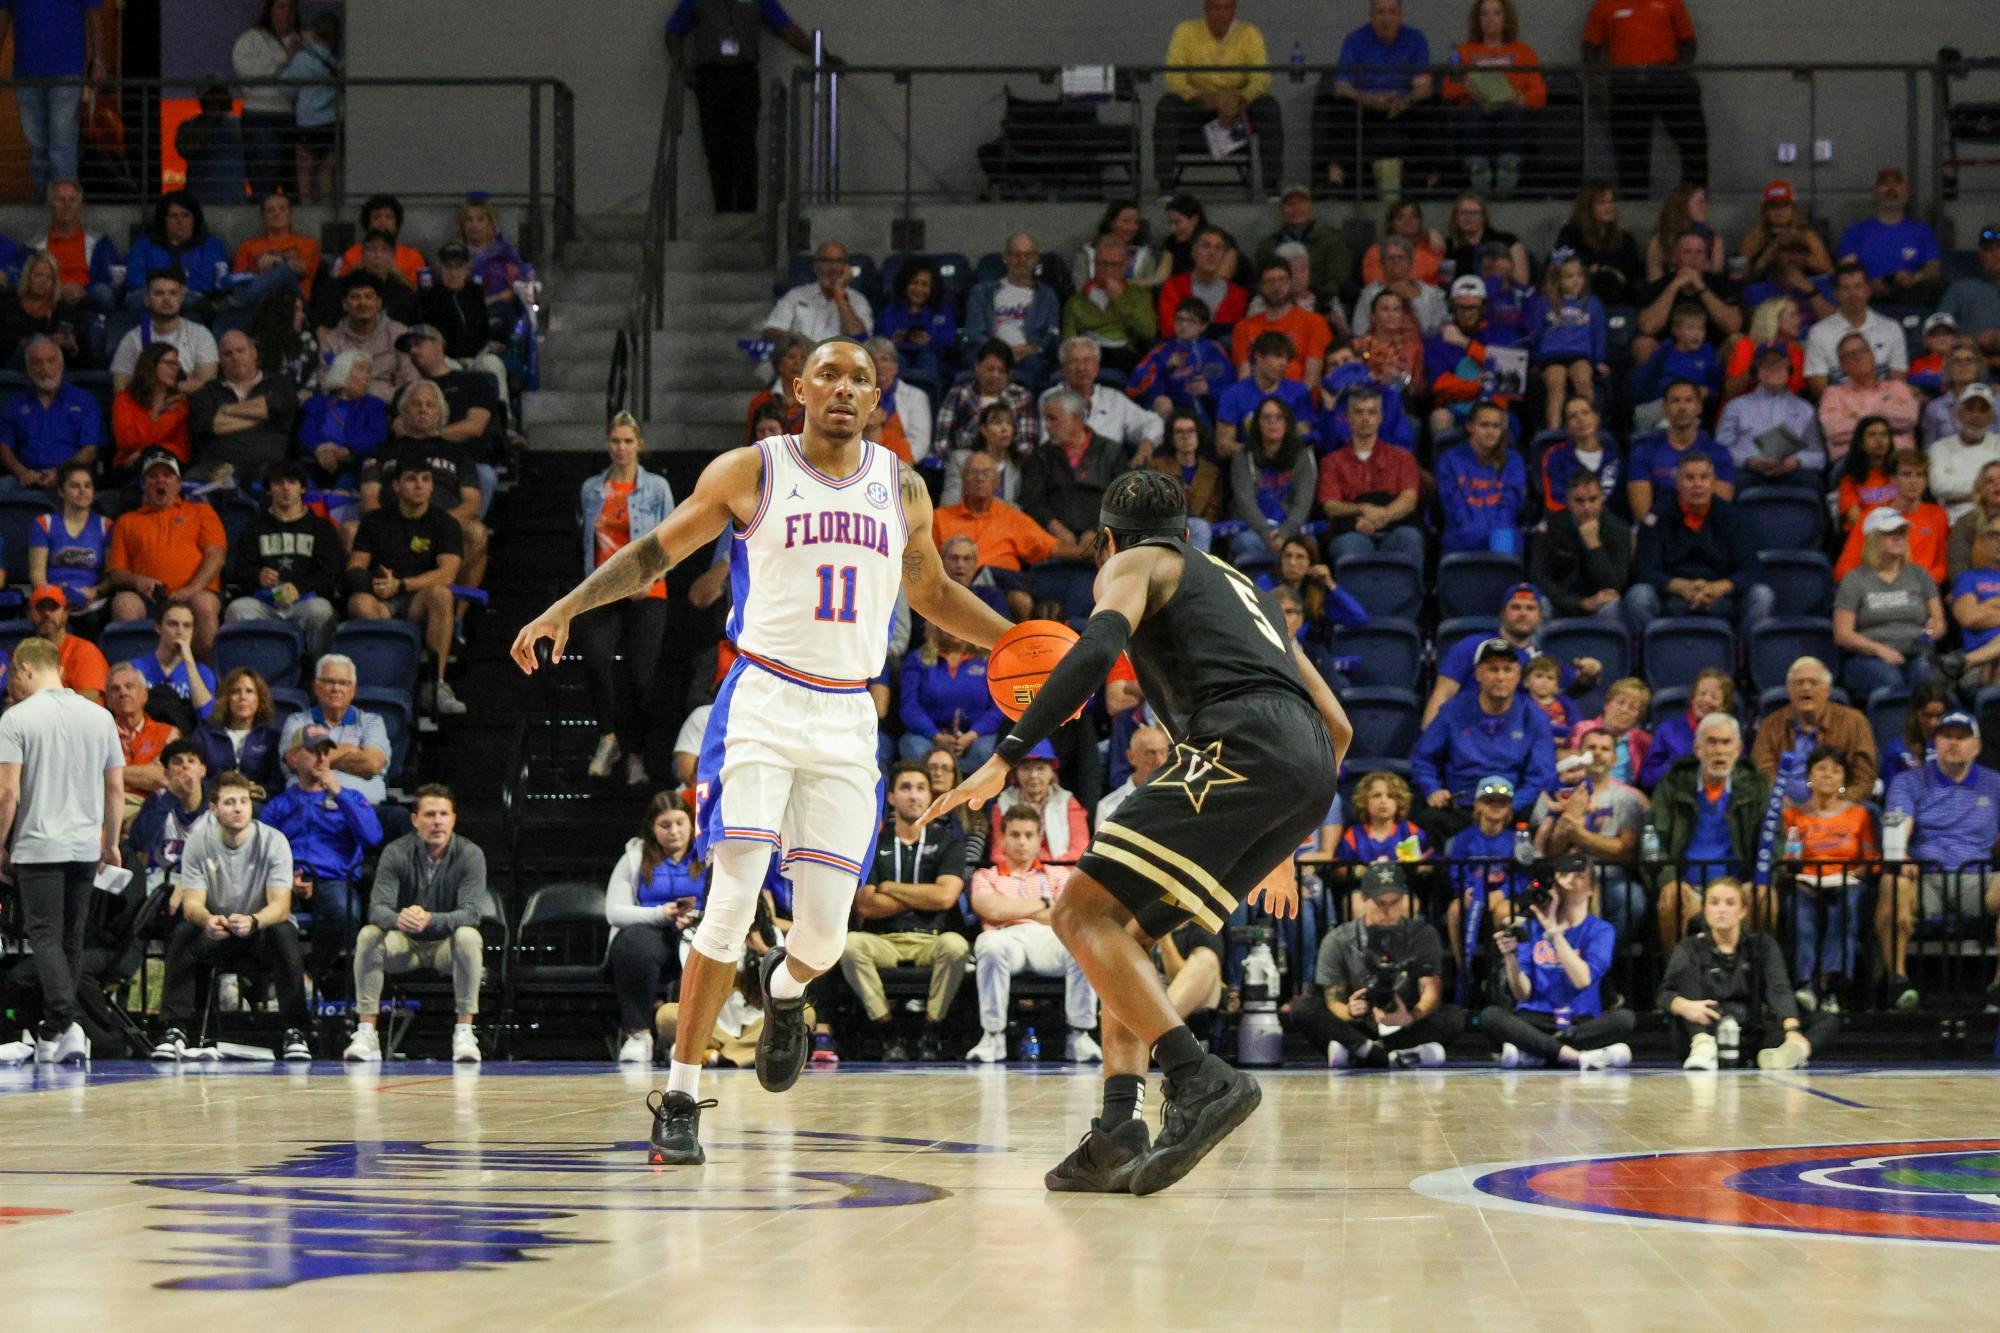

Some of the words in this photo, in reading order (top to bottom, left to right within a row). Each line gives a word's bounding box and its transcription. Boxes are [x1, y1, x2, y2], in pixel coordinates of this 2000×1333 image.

[870, 484, 888, 502] SEC
[785, 510, 889, 558] FLORIDA
[814, 564, 858, 623] 11
[1224, 572, 1287, 653] 5
[1184, 753, 1213, 783] V
